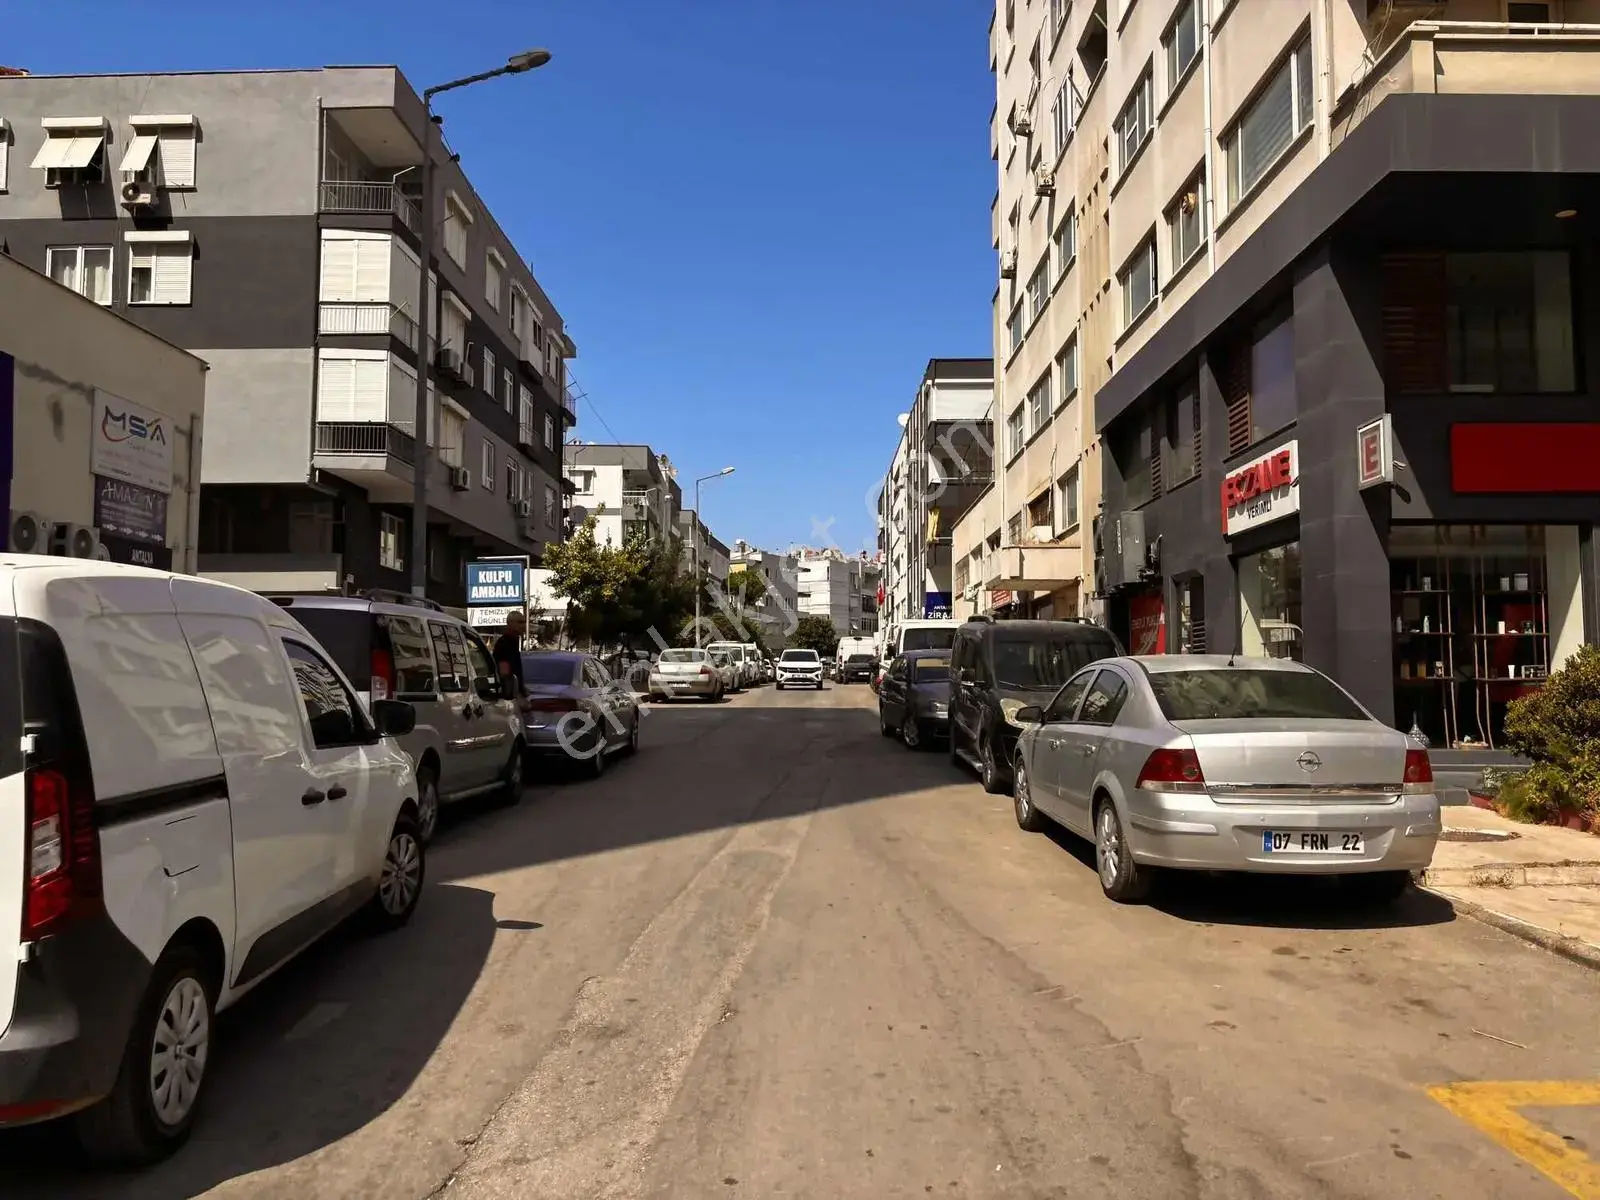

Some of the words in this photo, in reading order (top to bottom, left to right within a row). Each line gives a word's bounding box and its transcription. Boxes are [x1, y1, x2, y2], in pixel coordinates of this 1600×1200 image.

[479, 571, 512, 583] KULPU
[471, 585, 519, 598] AMBALAJ
[1273, 833, 1291, 849] 07
[1301, 834, 1328, 850] FRN
[1342, 834, 1360, 850] 22
